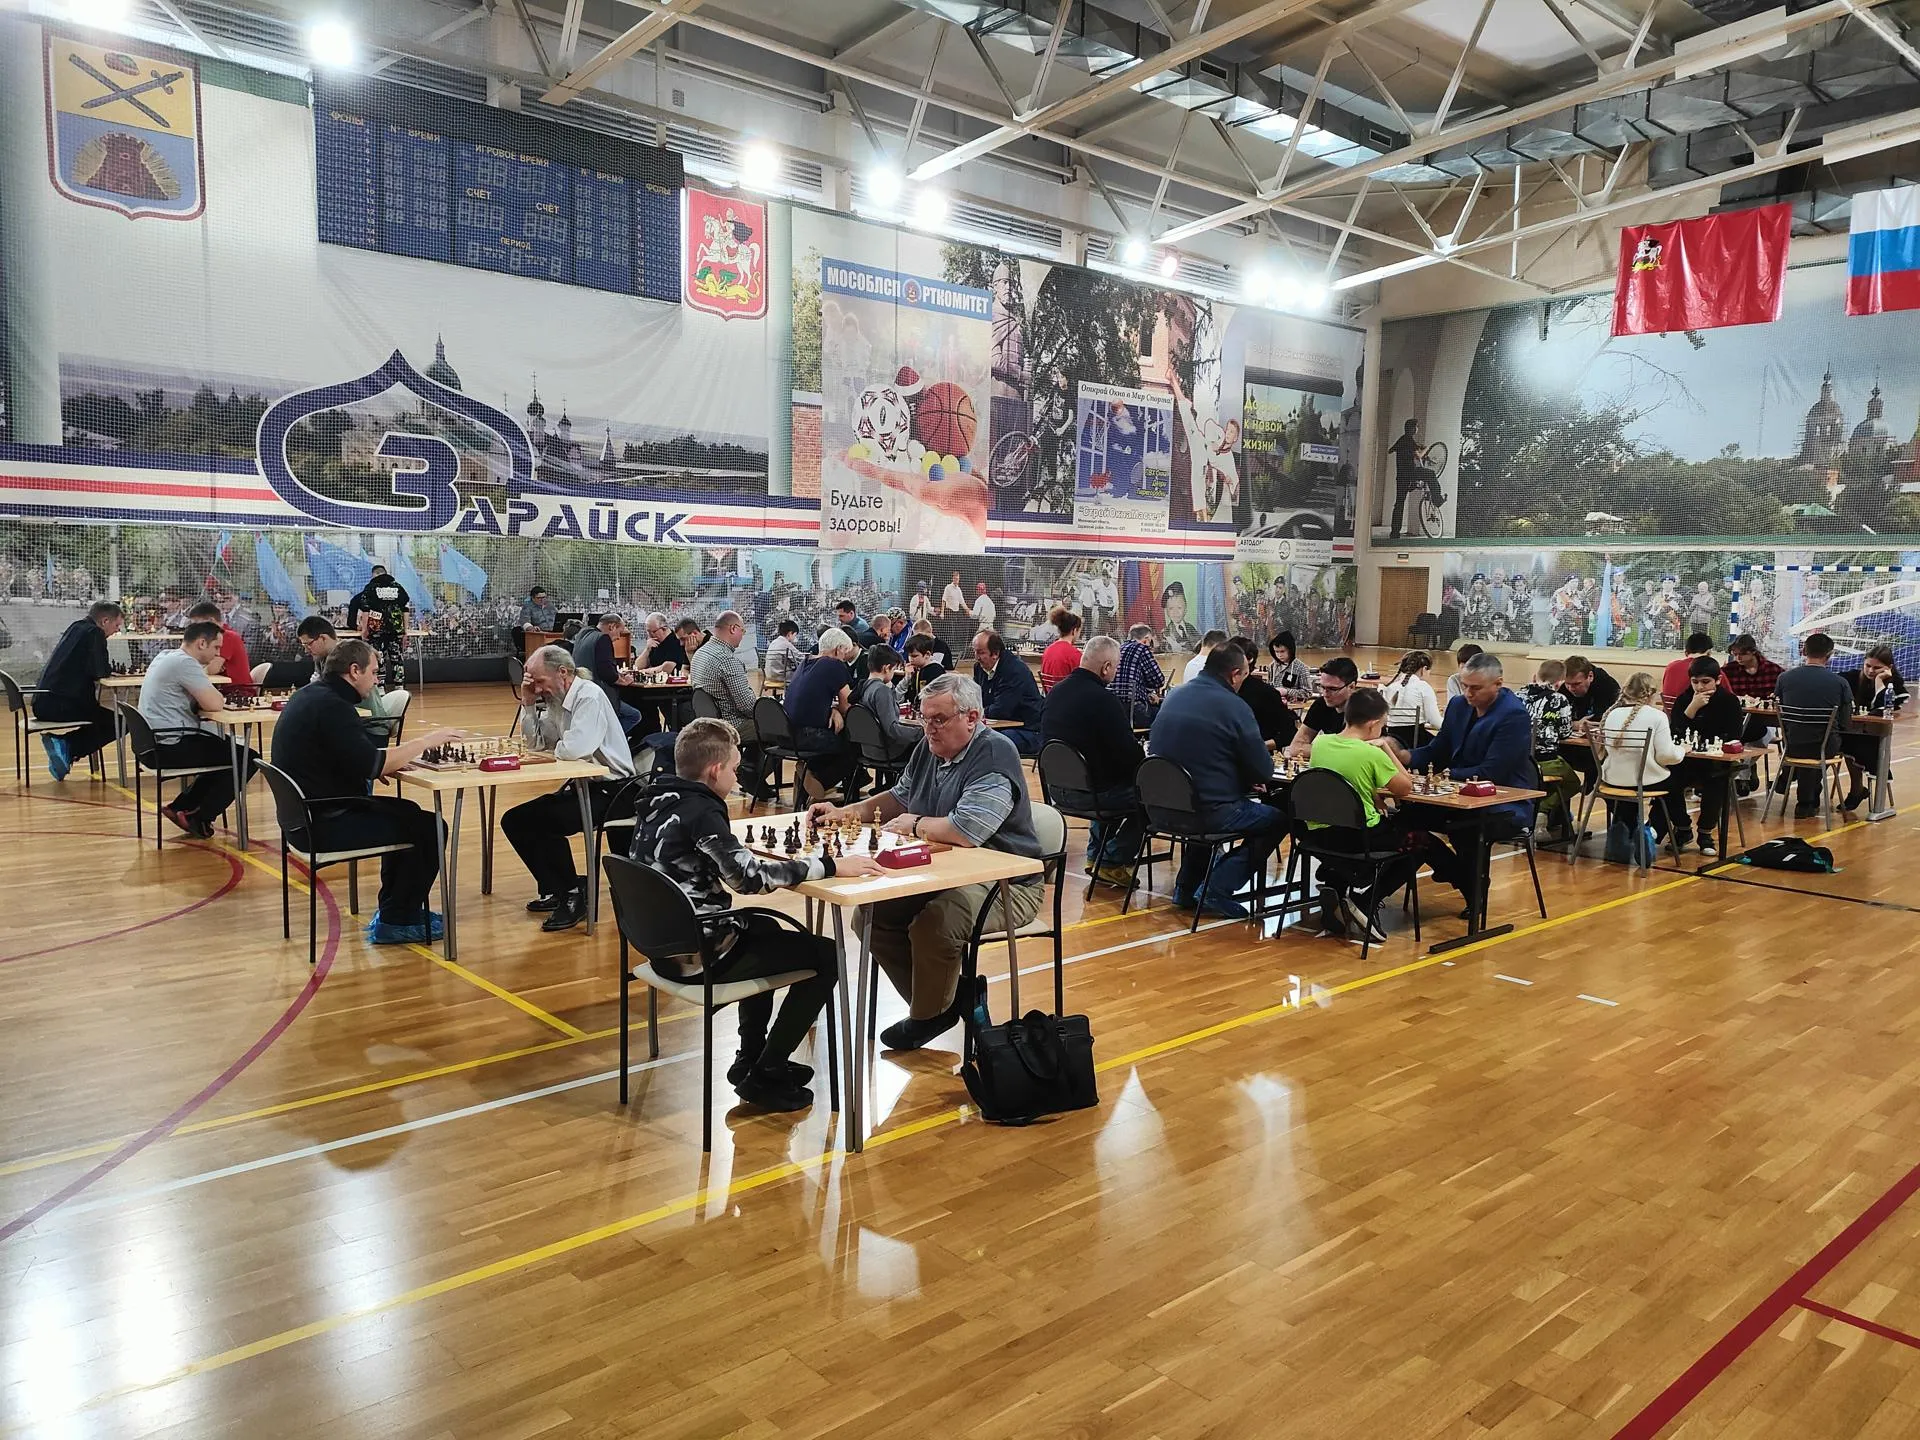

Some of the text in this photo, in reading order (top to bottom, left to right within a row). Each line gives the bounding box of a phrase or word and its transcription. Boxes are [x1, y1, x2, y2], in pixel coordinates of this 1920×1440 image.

[408, 128, 440, 142] ВРЕМЯ
[475, 144, 549, 167] ИГРОВОЕ ВРЕМЯ
[596, 171, 625, 185] ВРЕМЯ
[500, 237, 531, 250] ПЕРИОД
[1131, 392, 1145, 402] Мир
[830, 489, 883, 511] Будьте
[829, 517, 901, 535] здоровы!
